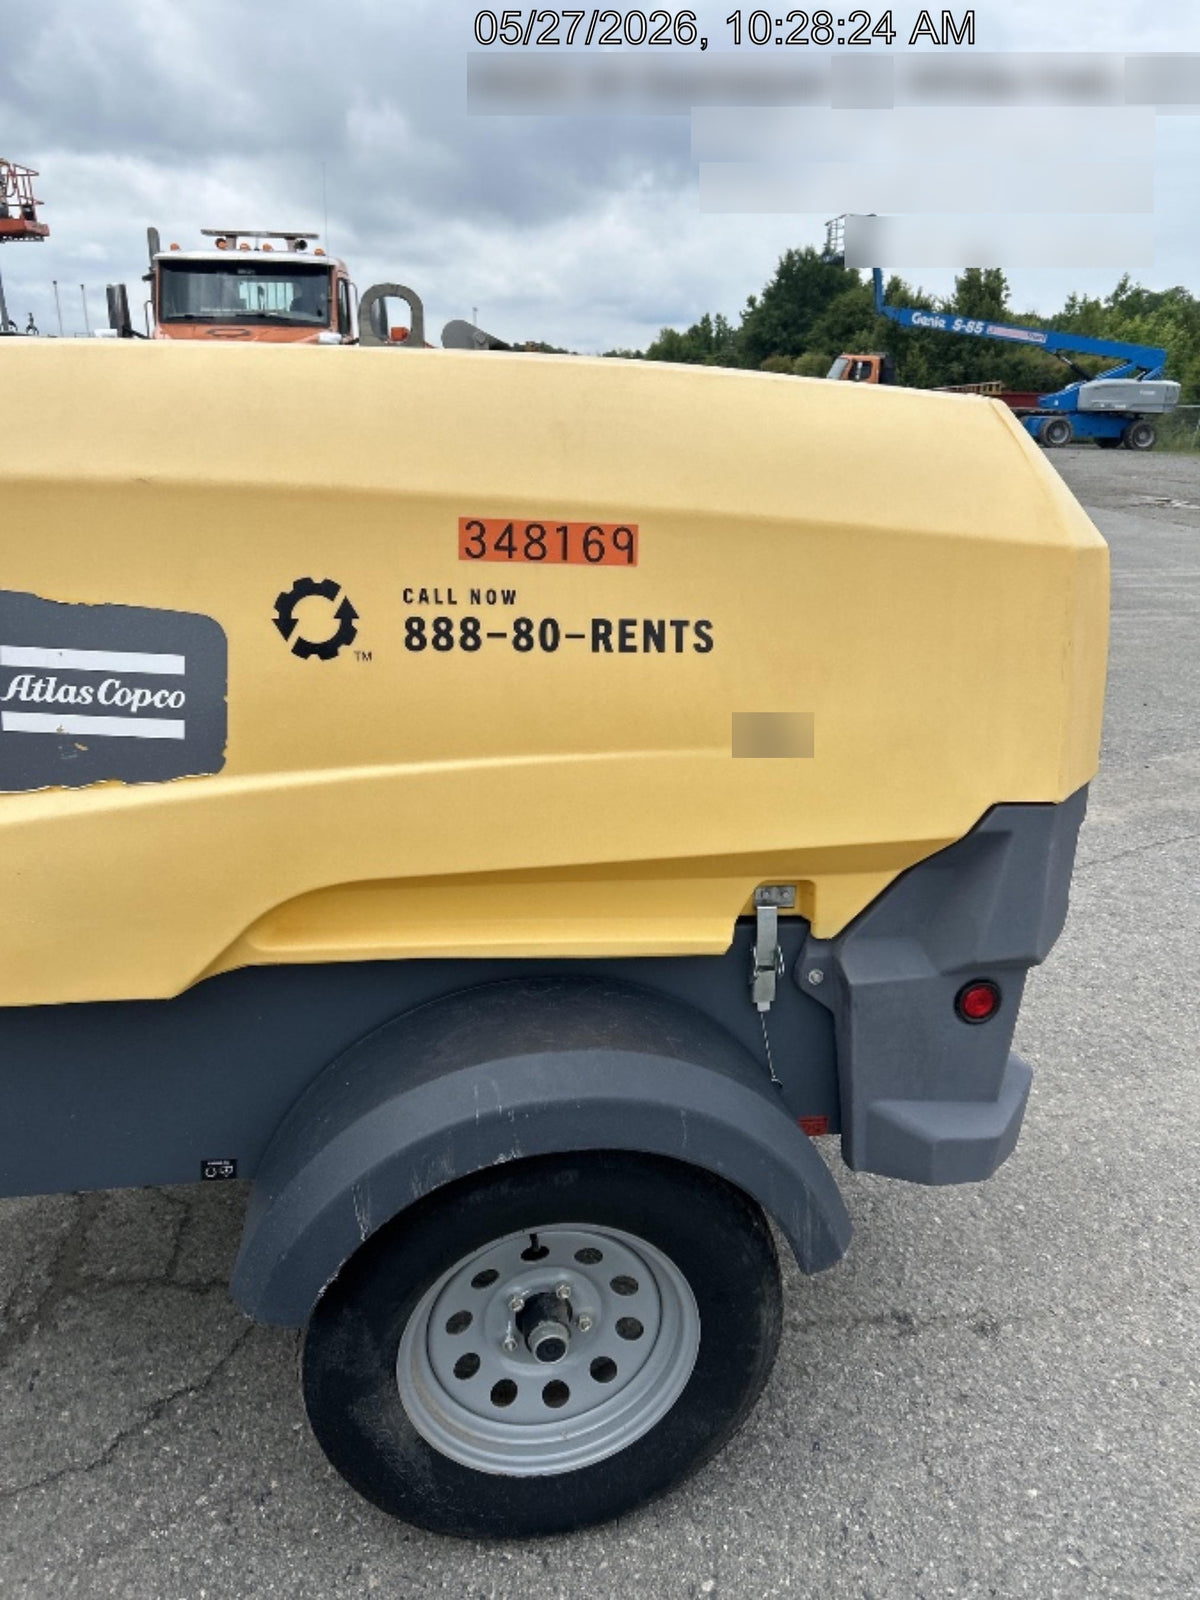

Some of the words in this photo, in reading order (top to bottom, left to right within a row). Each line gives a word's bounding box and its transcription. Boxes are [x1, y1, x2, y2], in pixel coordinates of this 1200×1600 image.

[911, 312, 946, 328] Genie
[464, 520, 635, 564] 348169
[402, 588, 457, 605] CALL
[470, 588, 516, 605] NOW
[404, 616, 714, 653] 888-80-RENTS
[354, 651, 372, 662] TM
[0, 674, 94, 705] Atlas
[97, 678, 185, 713] Copco
